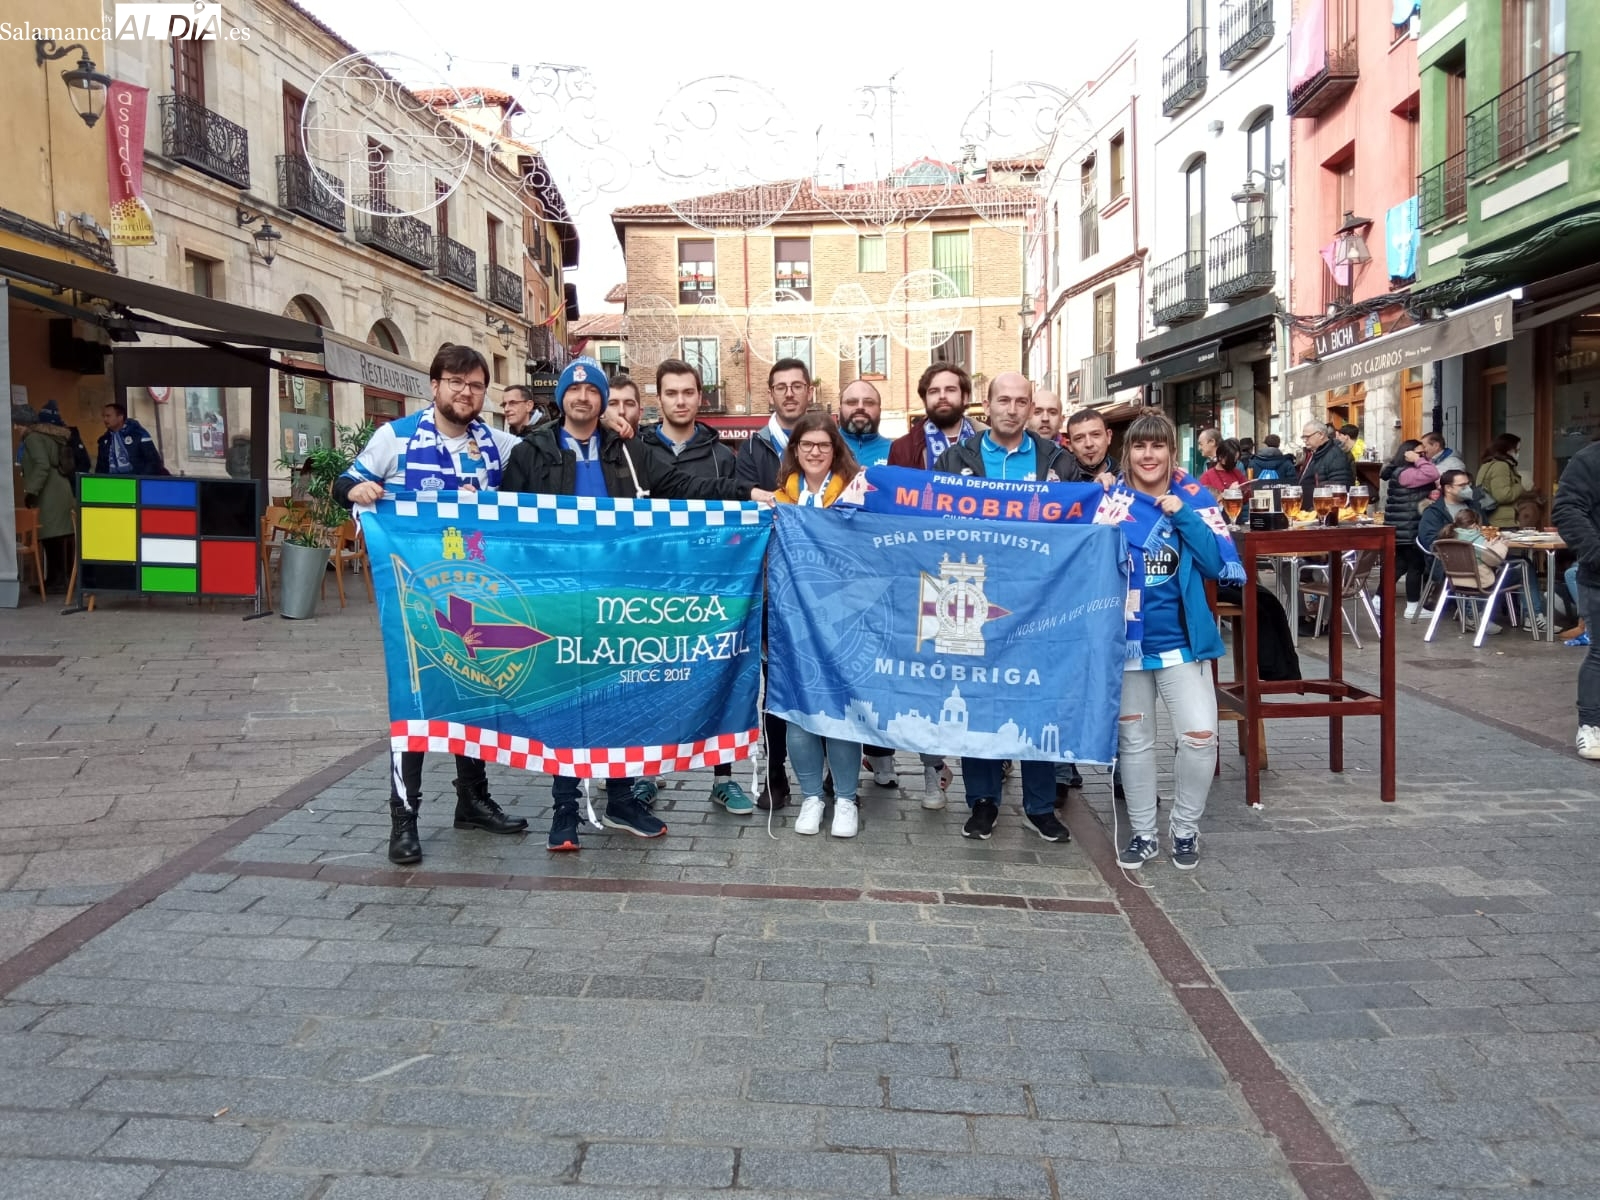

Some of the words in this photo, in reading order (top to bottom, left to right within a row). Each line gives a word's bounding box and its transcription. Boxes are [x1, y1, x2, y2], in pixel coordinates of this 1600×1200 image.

[117, 91, 133, 194] asador
[1315, 336, 1328, 355] LA
[360, 354, 423, 395] RESTAURANTE
[1364, 348, 1403, 374] CAZURROS
[718, 429, 748, 438] CADO
[932, 475, 964, 487] PEÑA
[966, 476, 1049, 493] DEPORTIVISTA
[872, 530, 918, 549] PEÑA
[923, 529, 1050, 556] DEPORTIVISTA
[424, 570, 499, 594] MESETA
[596, 595, 729, 625] MESETA
[1037, 615, 1057, 632] VAN
[1059, 613, 1067, 625] A
[1068, 605, 1086, 621] VER
[1086, 596, 1120, 613] VOLVER
[555, 630, 750, 665] BLANQUIAZUL
[442, 652, 524, 691] BLANQZUL
[620, 669, 661, 684] SINCE
[664, 667, 691, 682] 2017
[874, 658, 1041, 686] MIRÓBRIGA
